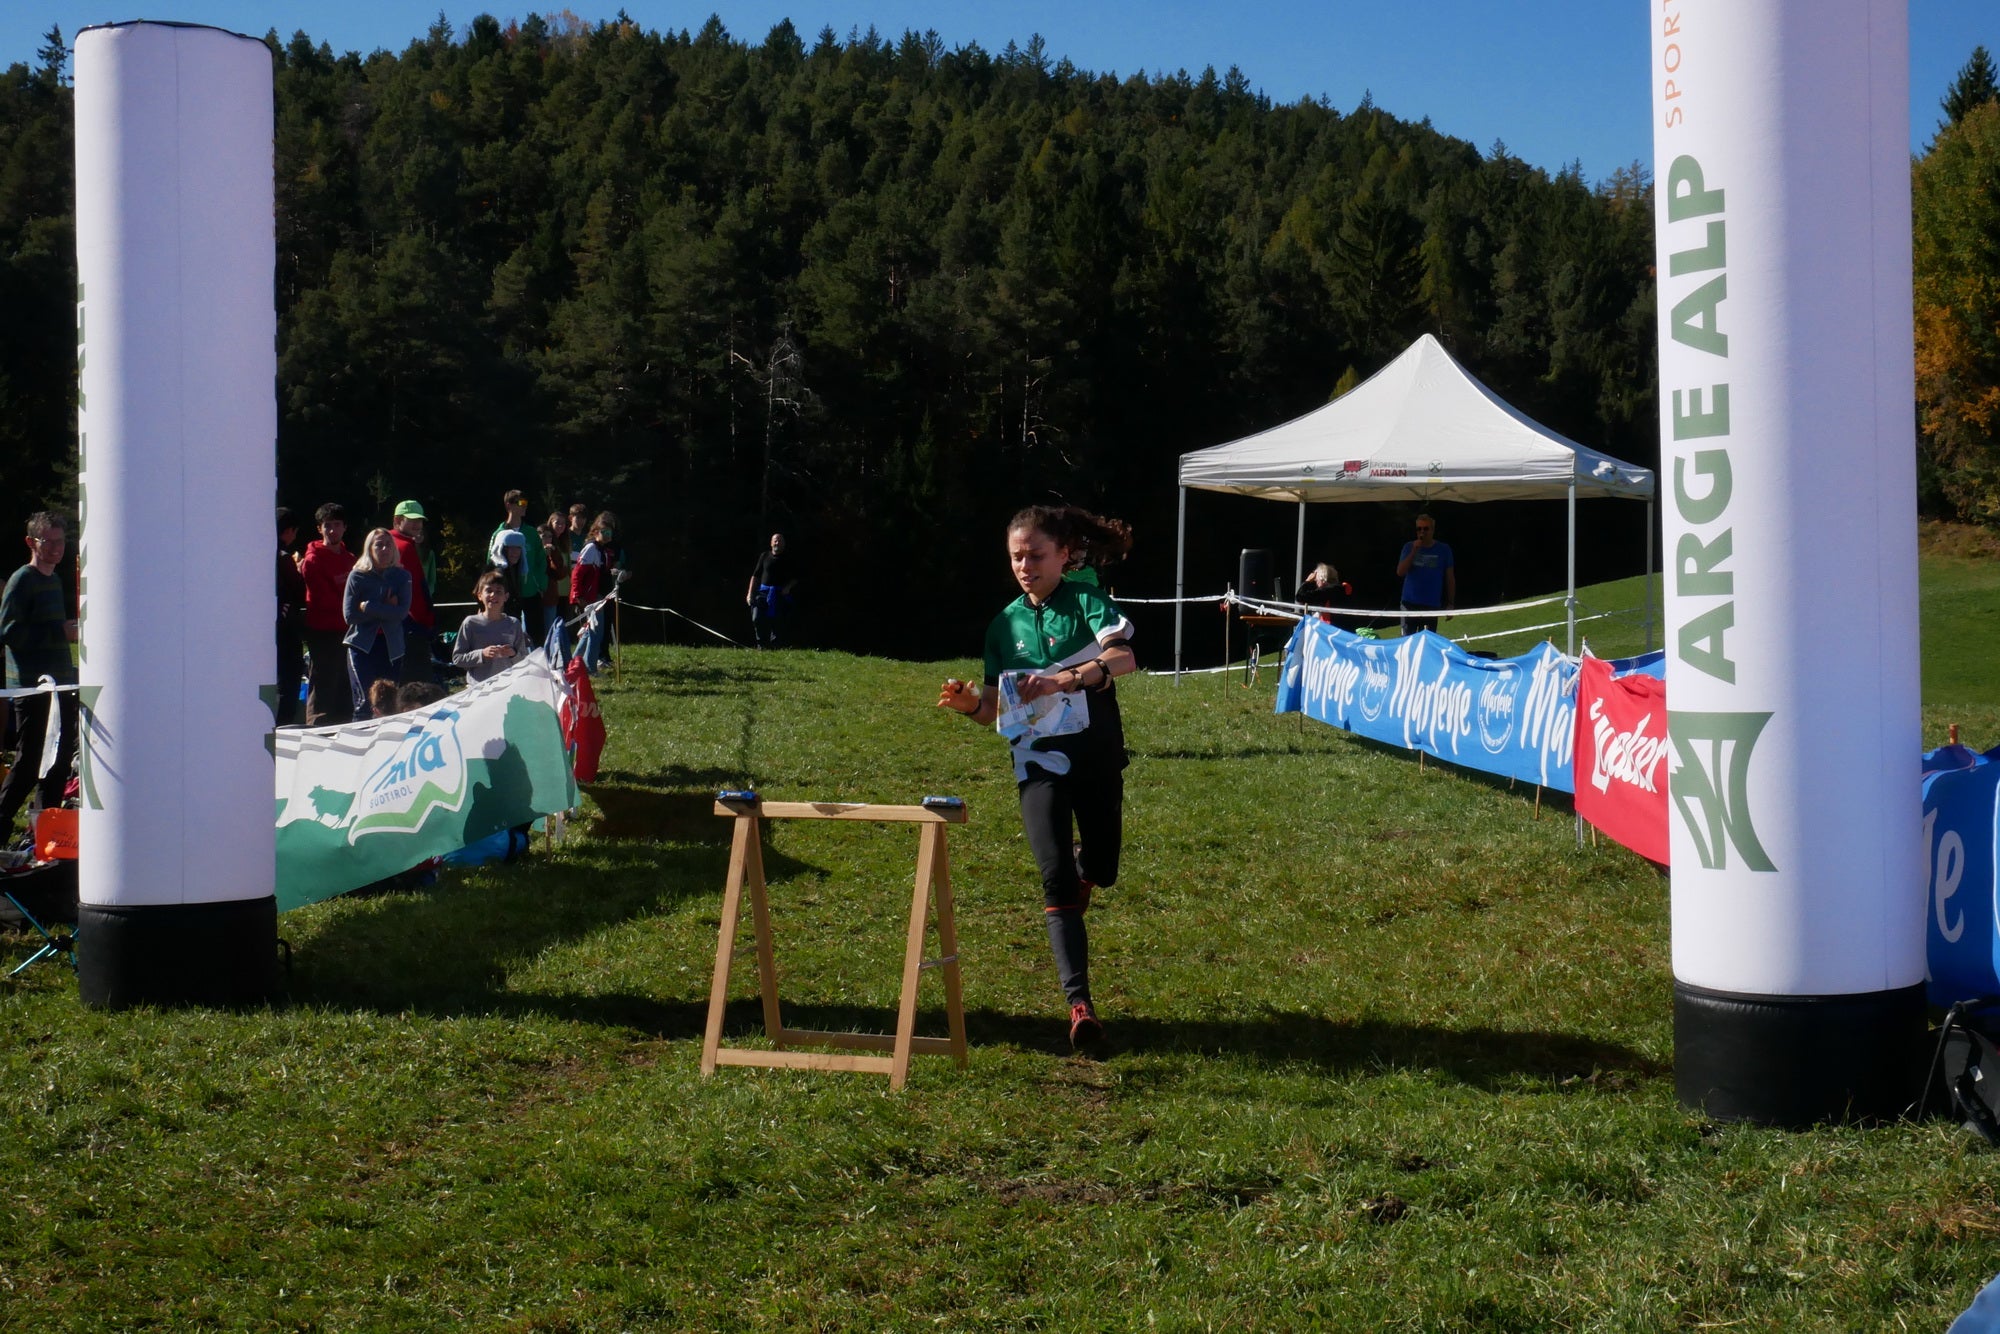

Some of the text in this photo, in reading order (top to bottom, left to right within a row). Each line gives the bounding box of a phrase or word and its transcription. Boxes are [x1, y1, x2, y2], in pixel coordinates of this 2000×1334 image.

[1667, 154, 1729, 359] ALP
[1370, 469, 1407, 477] MERAN
[1672, 382, 1736, 686] ARGE
[1389, 634, 1472, 756] Marlene
